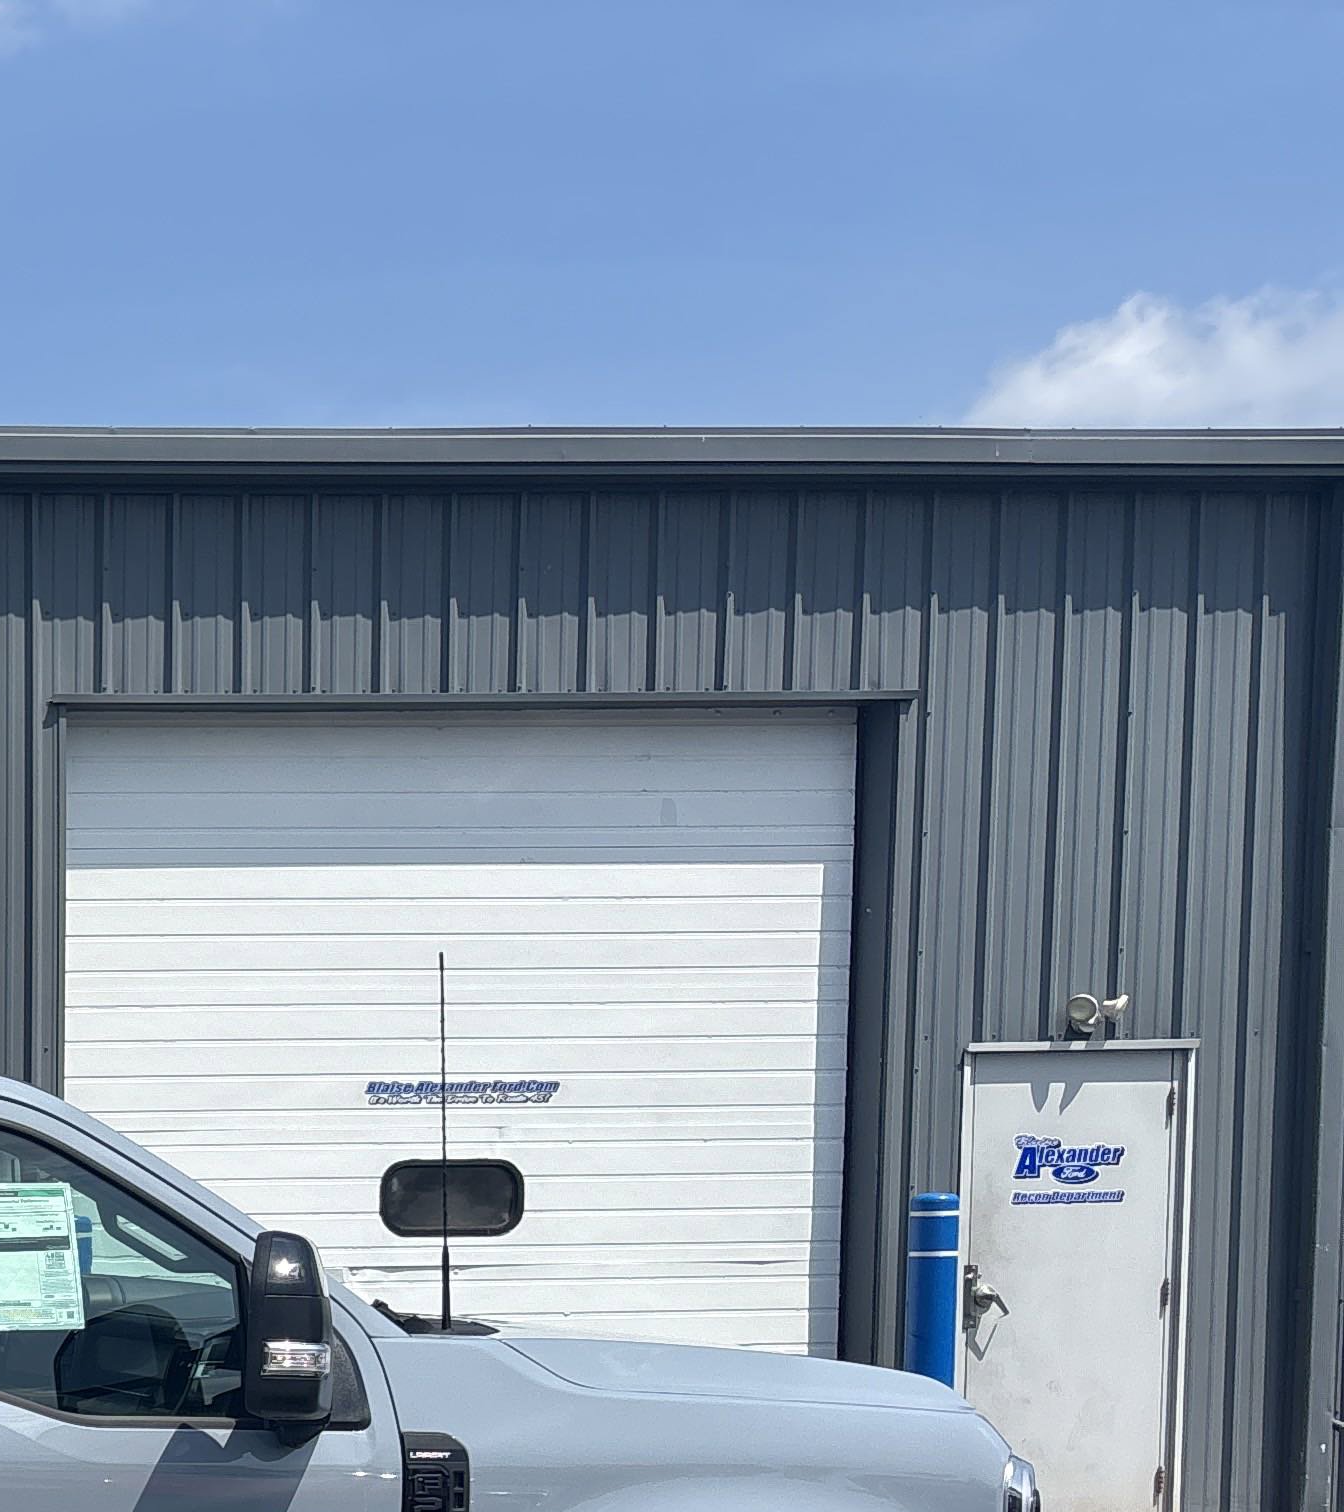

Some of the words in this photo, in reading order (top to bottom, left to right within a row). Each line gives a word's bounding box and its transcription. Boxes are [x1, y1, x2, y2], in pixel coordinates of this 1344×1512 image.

[1014, 1145, 1124, 1177] Alexander
[1061, 1167, 1086, 1178] Ford
[1052, 1190, 1124, 1203] Department
